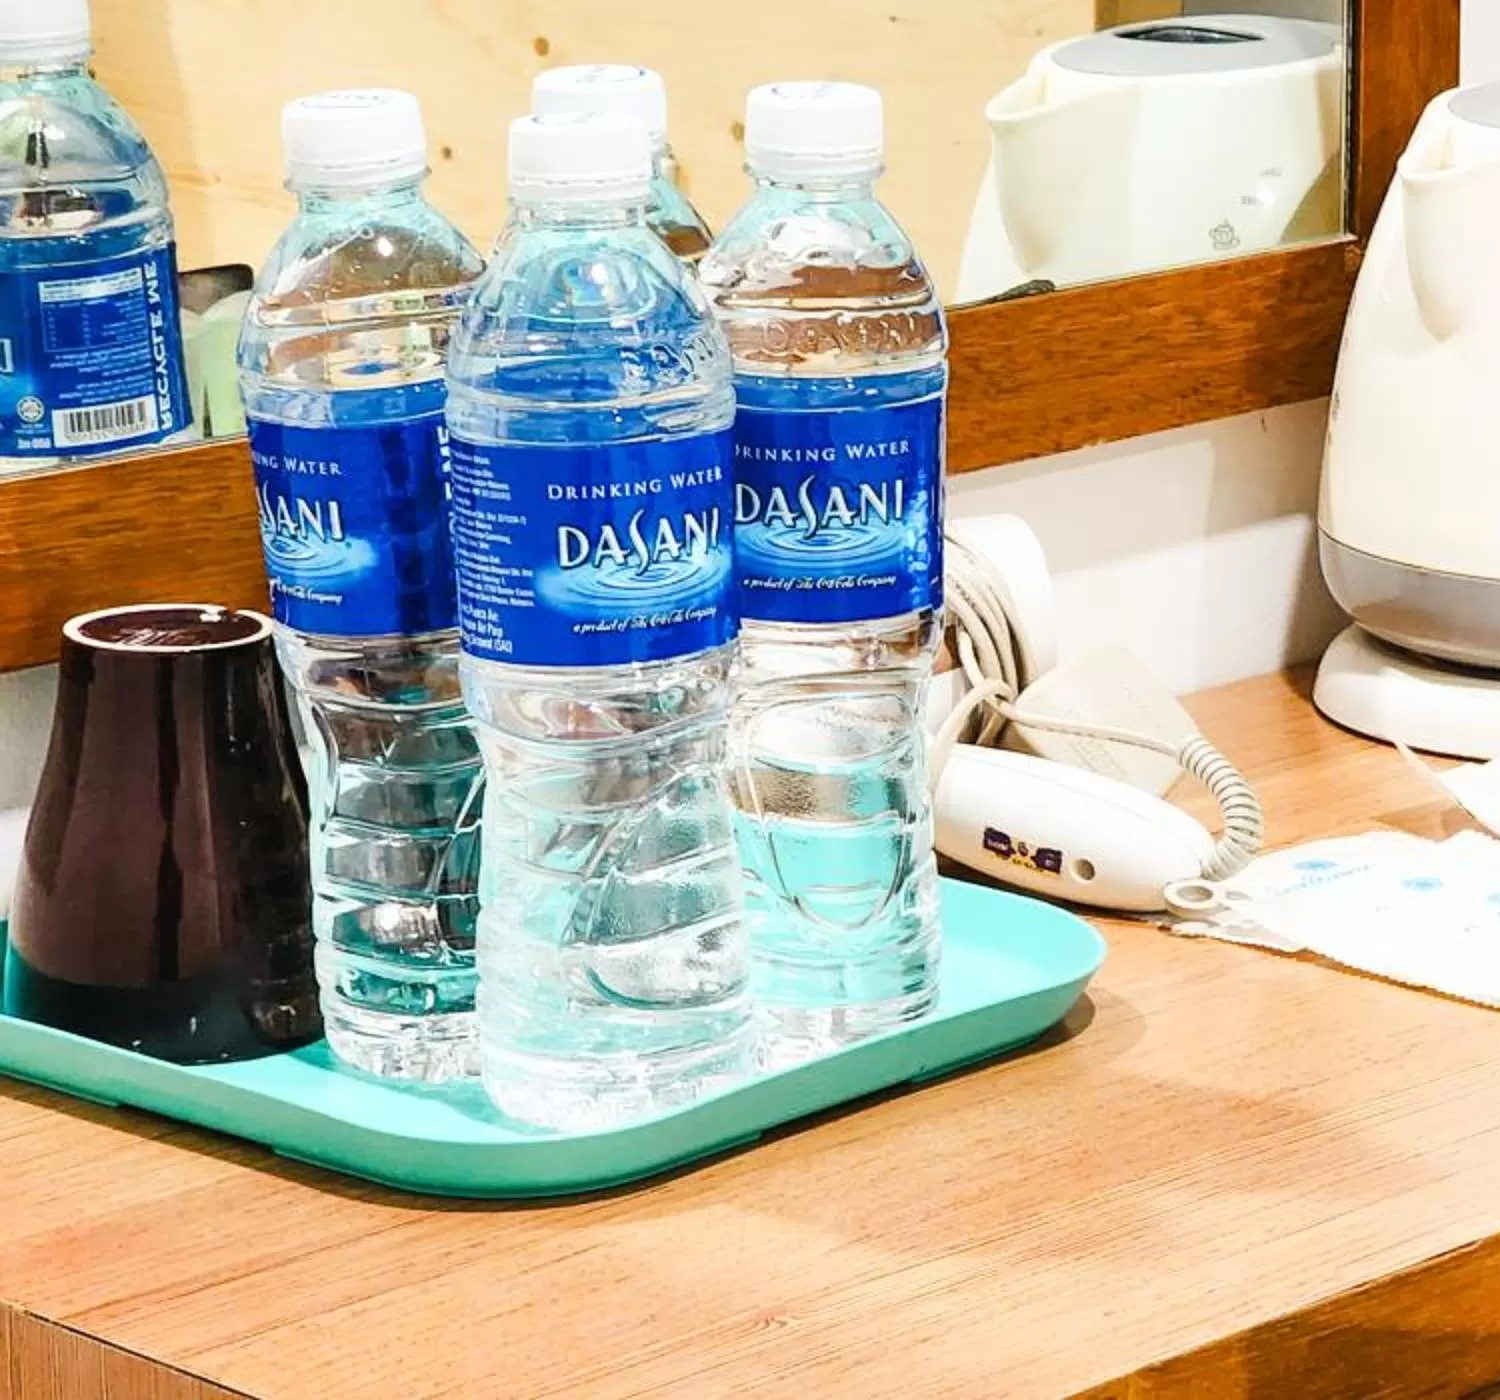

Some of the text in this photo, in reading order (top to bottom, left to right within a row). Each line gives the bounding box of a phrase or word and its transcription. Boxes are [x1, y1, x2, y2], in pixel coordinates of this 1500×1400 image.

[283, 457, 343, 475] WATER
[845, 440, 910, 460] WATER
[548, 465, 723, 501] DRINKING WATER
[735, 474, 904, 540] DASANI
[558, 507, 720, 576] DASANI
